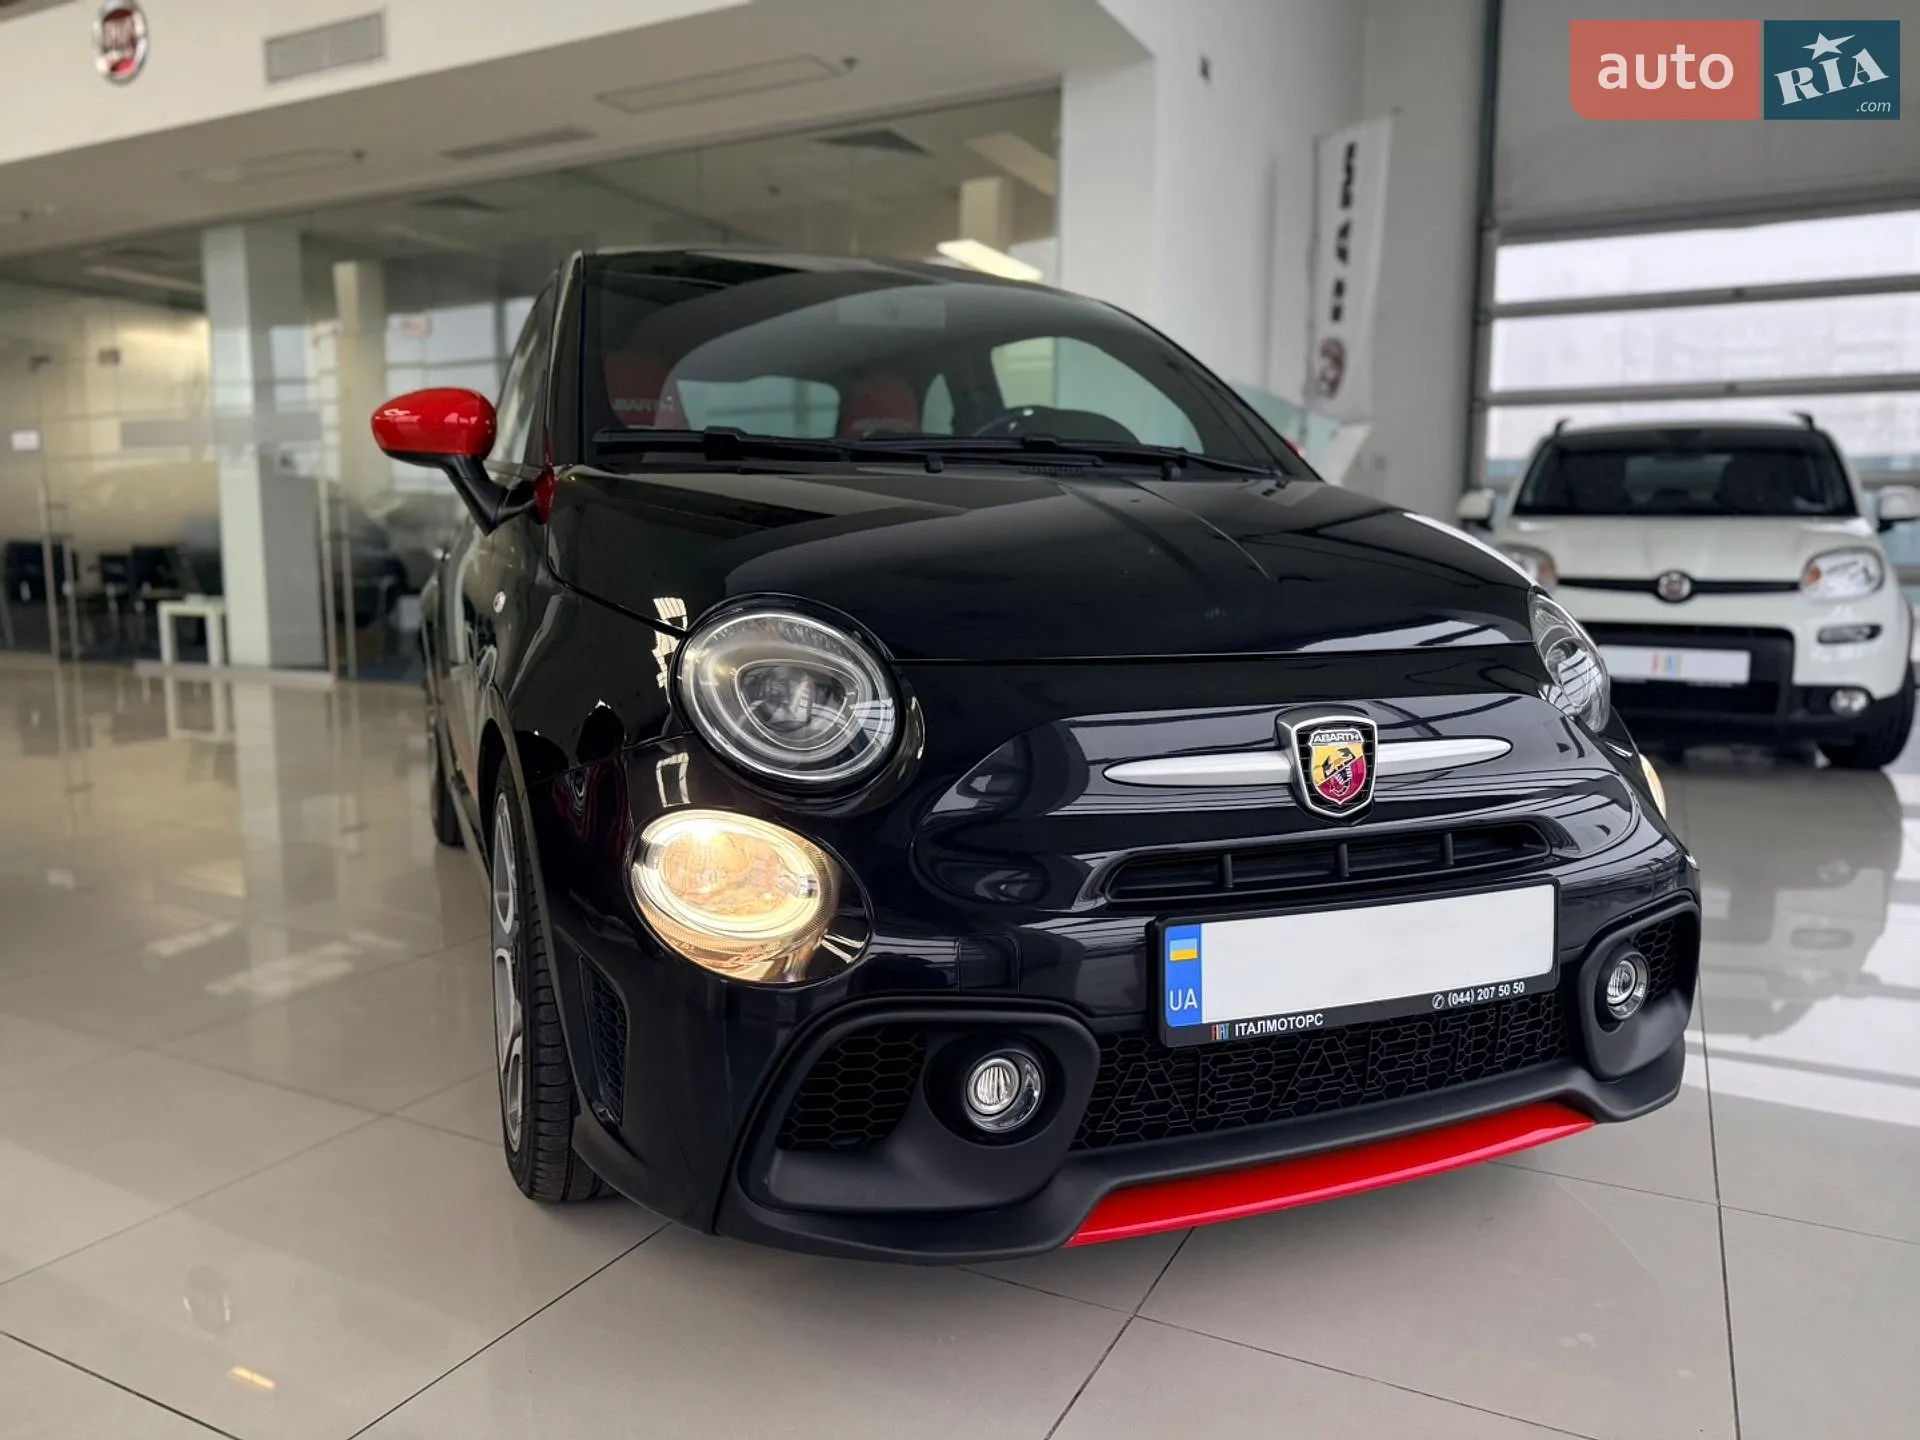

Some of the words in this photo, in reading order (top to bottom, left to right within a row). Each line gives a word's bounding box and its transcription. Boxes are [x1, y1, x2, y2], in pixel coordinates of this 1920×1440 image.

[1313, 732, 1360, 743] ABARTH
[1170, 988, 1198, 1011] UA
[1448, 988, 1475, 1007] (044)
[1477, 986, 1496, 1001] 207
[1498, 984, 1511, 997] 50
[1513, 981, 1525, 994] 50
[1235, 1013, 1324, 1037] ІТАЛМОТОРС
